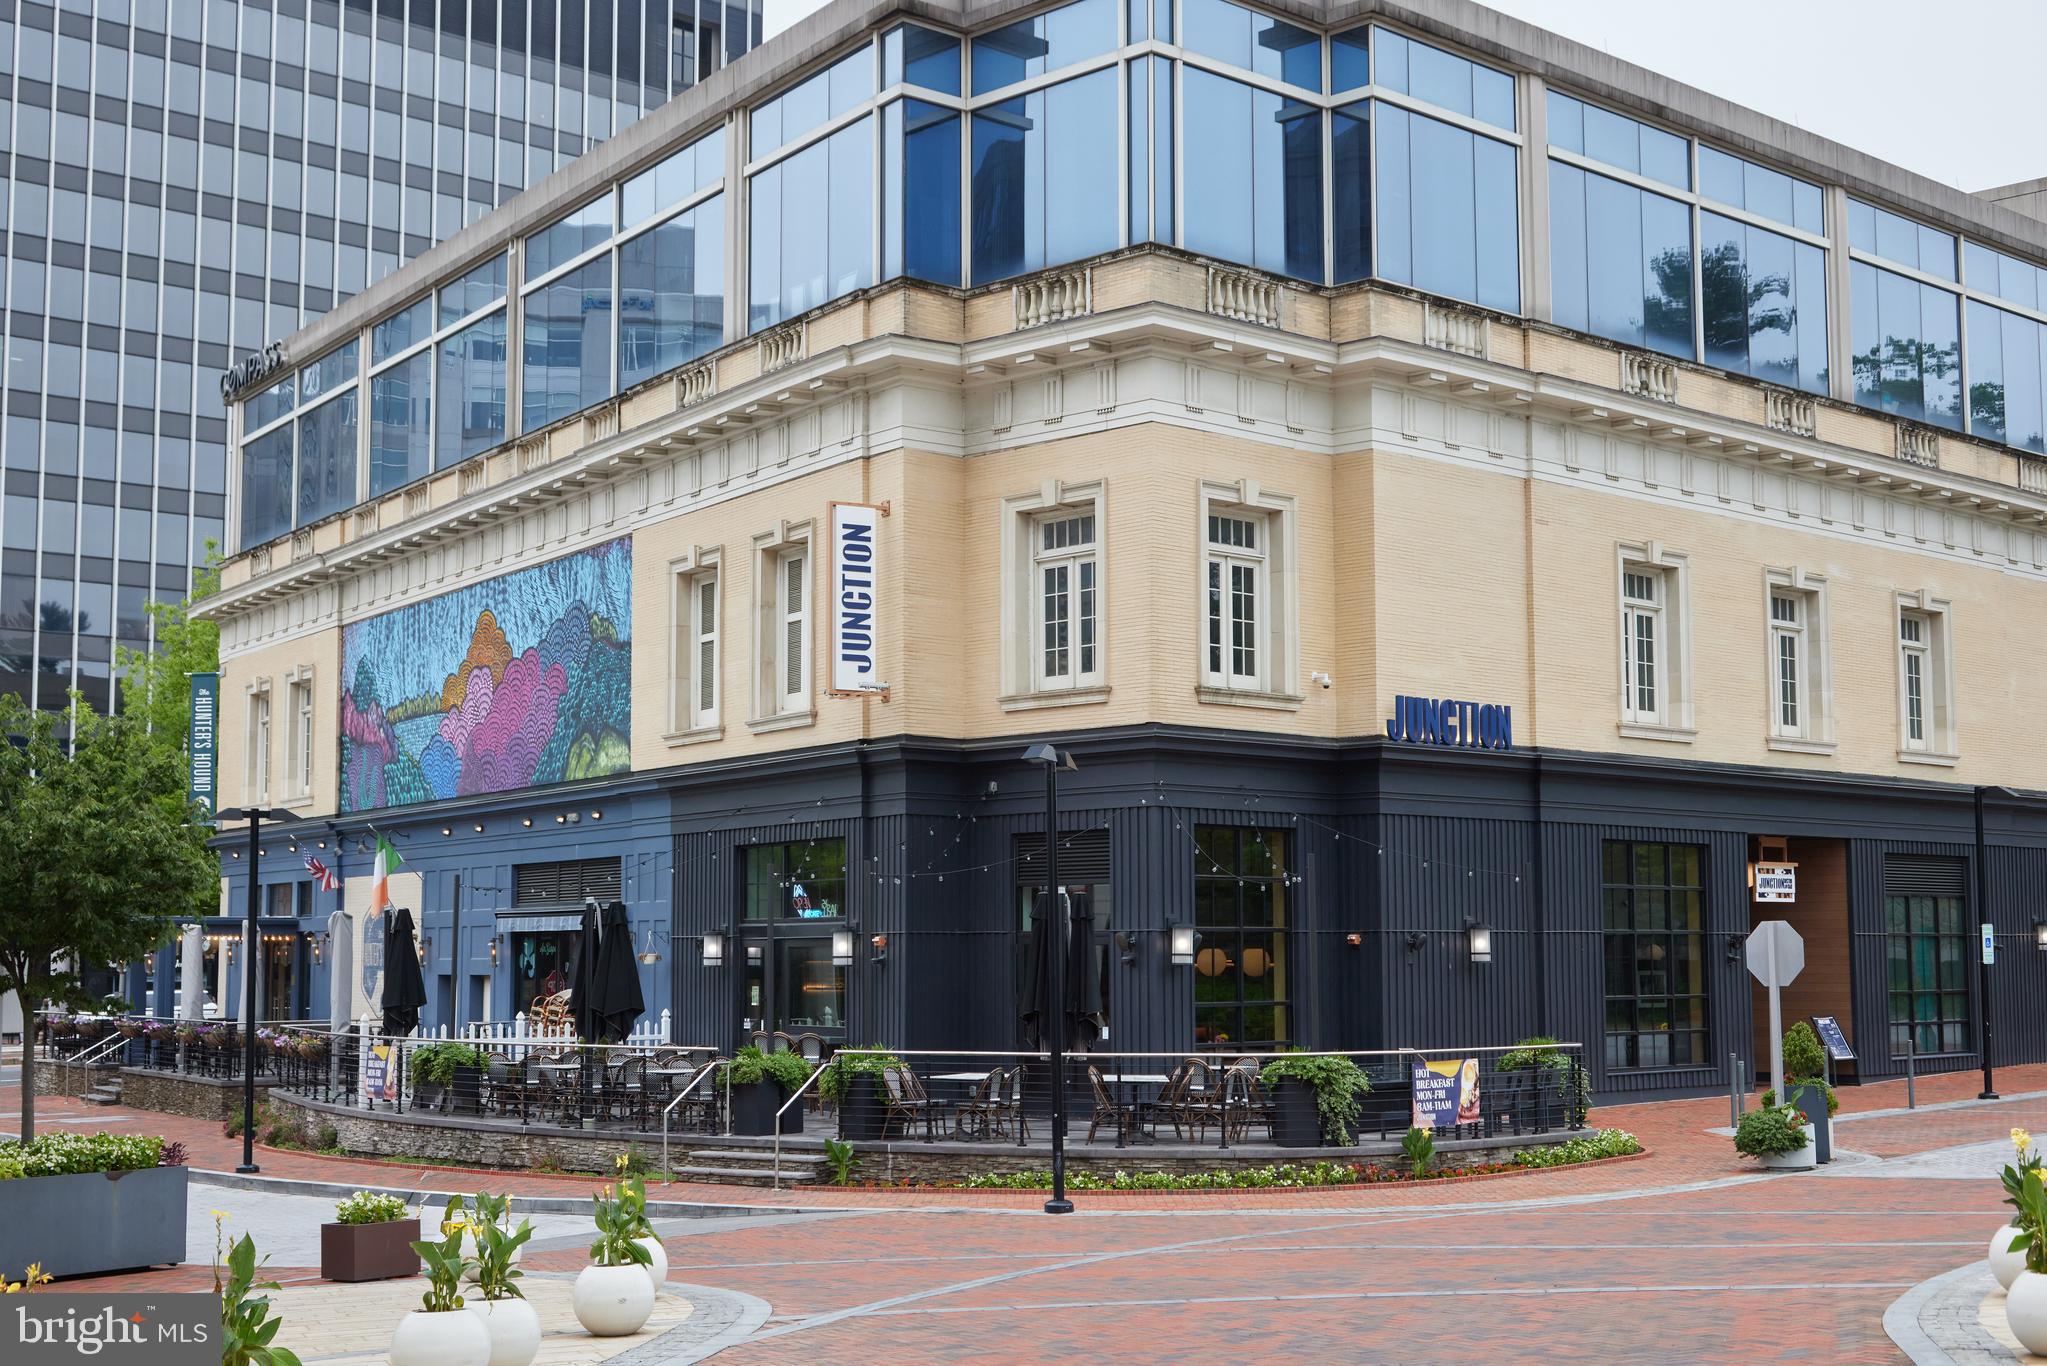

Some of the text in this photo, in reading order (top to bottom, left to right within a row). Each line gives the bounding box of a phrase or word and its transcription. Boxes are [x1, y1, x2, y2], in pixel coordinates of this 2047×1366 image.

[220, 339, 283, 397] COMPASS
[842, 523, 872, 674] JUNCTION
[1386, 695, 1512, 750] JUNCTION
[193, 697, 212, 792] HUNTER'S HOUND
[1759, 877, 1784, 889] JUNCTION
[1415, 1068, 1430, 1079] HOT
[1416, 1078, 1455, 1090] BREAKFAST
[1416, 1090, 1446, 1101] MON-FRI
[1416, 1100, 1452, 1112] 8AM-11AM
